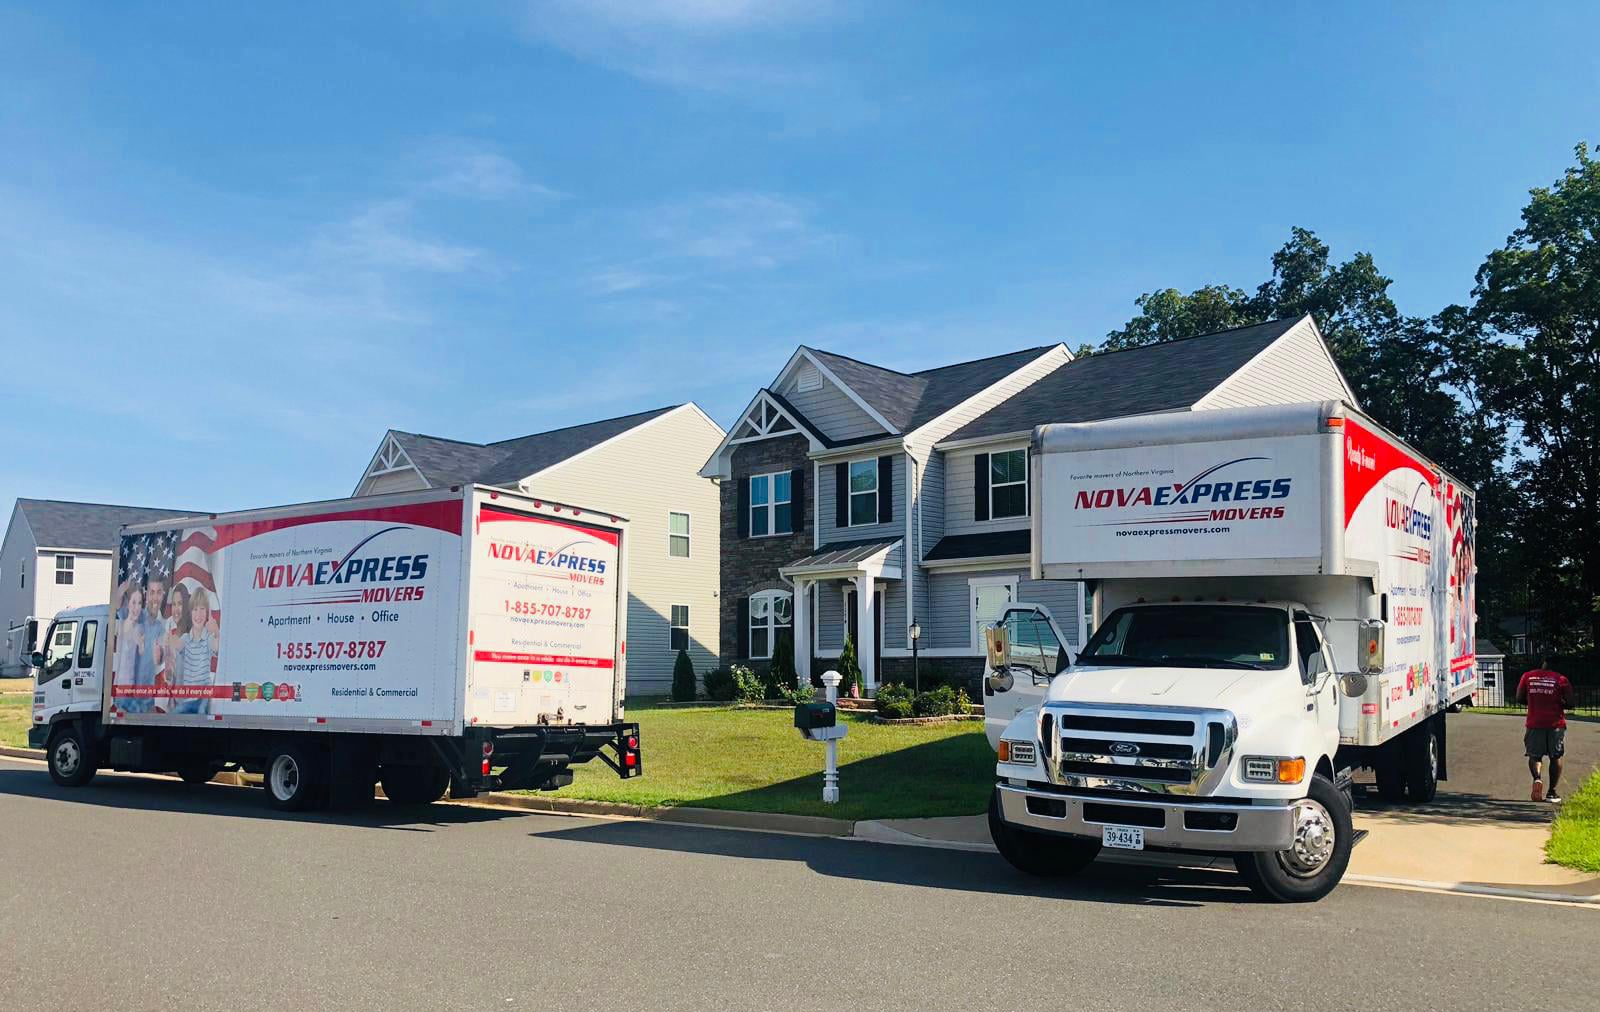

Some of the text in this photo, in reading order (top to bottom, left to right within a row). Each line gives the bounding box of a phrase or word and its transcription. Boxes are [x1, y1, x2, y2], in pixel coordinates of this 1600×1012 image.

[1074, 478, 1292, 510] NOVAEXPRESS
[1209, 506, 1285, 522] MOVERS
[1116, 526, 1230, 538] novaexpressmovers.com
[250, 552, 268, 560] Favorite
[314, 547, 332, 555] Virginia
[488, 542, 606, 574] NOVAEXPRESS
[252, 554, 429, 590] NOVAEXPRESS
[568, 573, 604, 586] MOVERS
[361, 586, 425, 603] MOVERS
[504, 600, 592, 620] 1-855-707-8787
[268, 610, 399, 628] Apartment House Office
[276, 640, 386, 660] 1-855-707-8787
[284, 662, 376, 673] novaexpressmovers.com
[332, 688, 418, 696] Residential & Commercial
[1116, 744, 1132, 753] Ford
